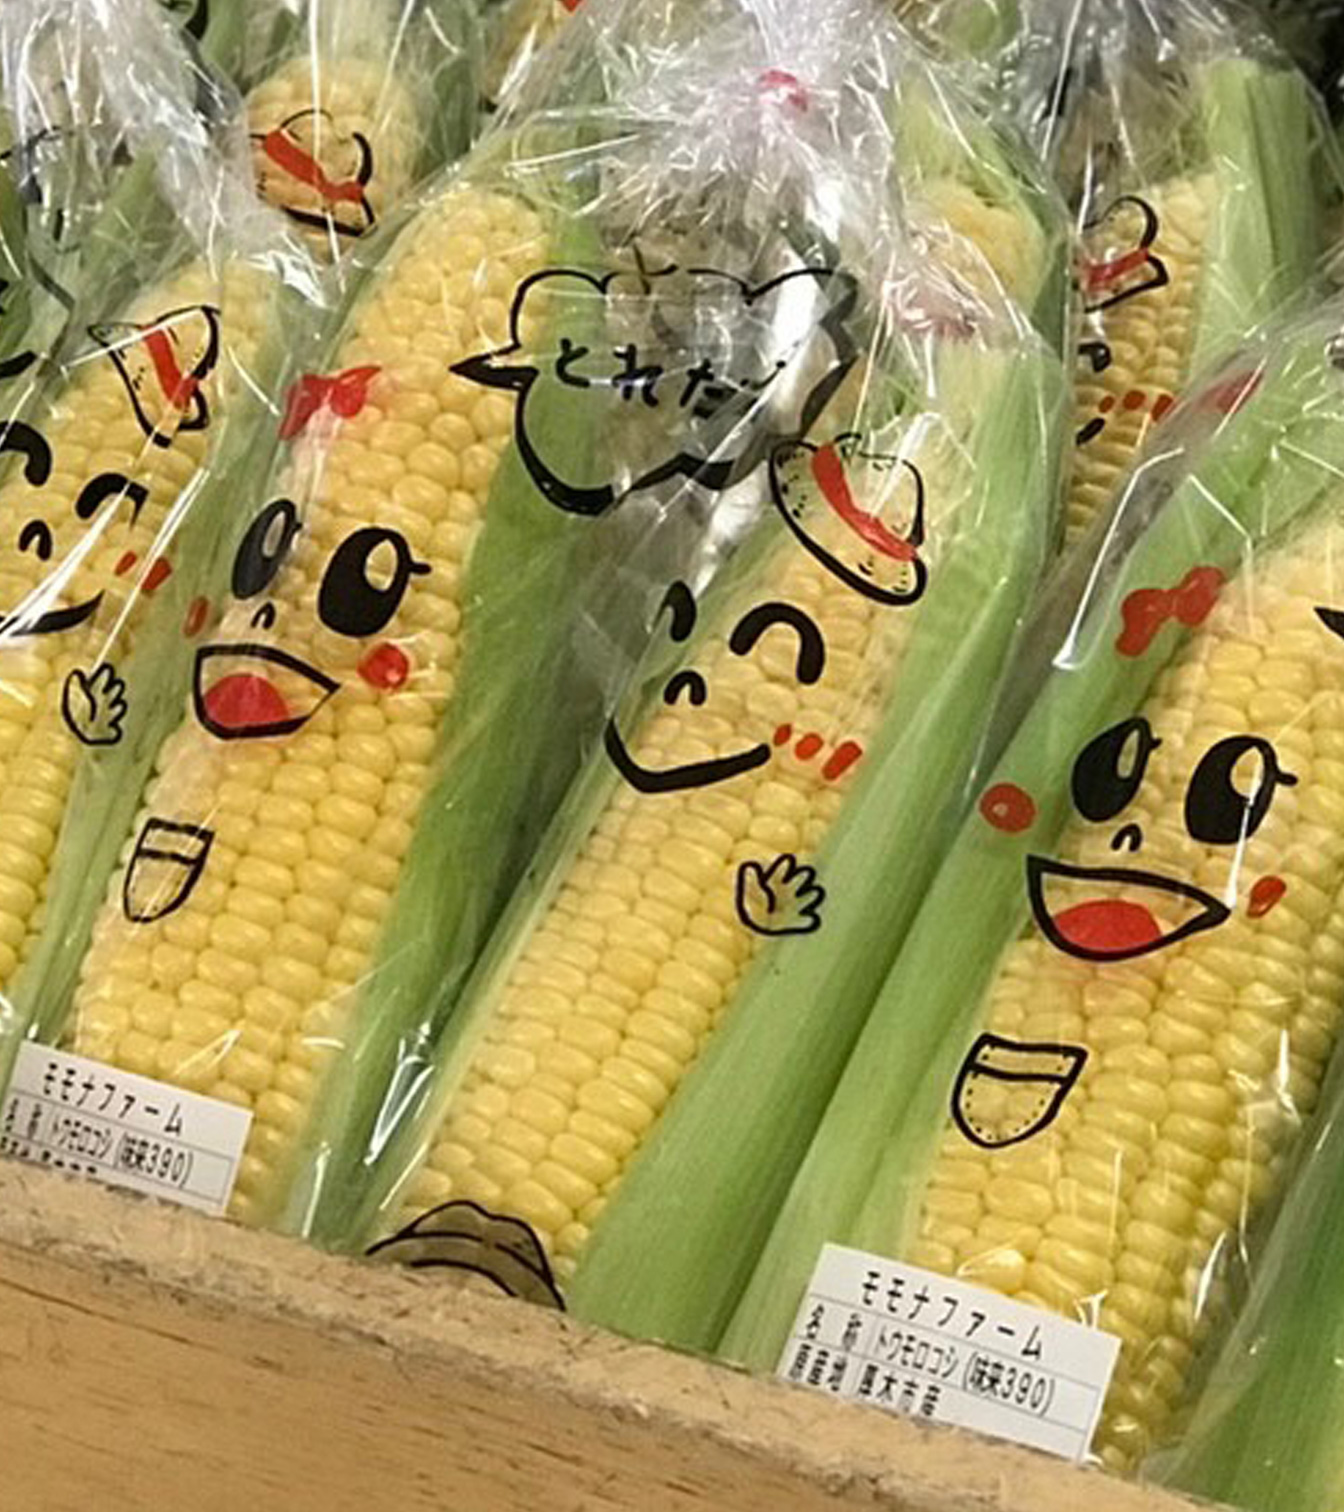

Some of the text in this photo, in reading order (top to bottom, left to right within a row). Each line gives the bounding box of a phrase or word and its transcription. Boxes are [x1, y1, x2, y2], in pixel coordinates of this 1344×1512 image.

[42, 1061, 184, 1137] モモナファーム
[860, 1270, 1043, 1362] モモナファーム
